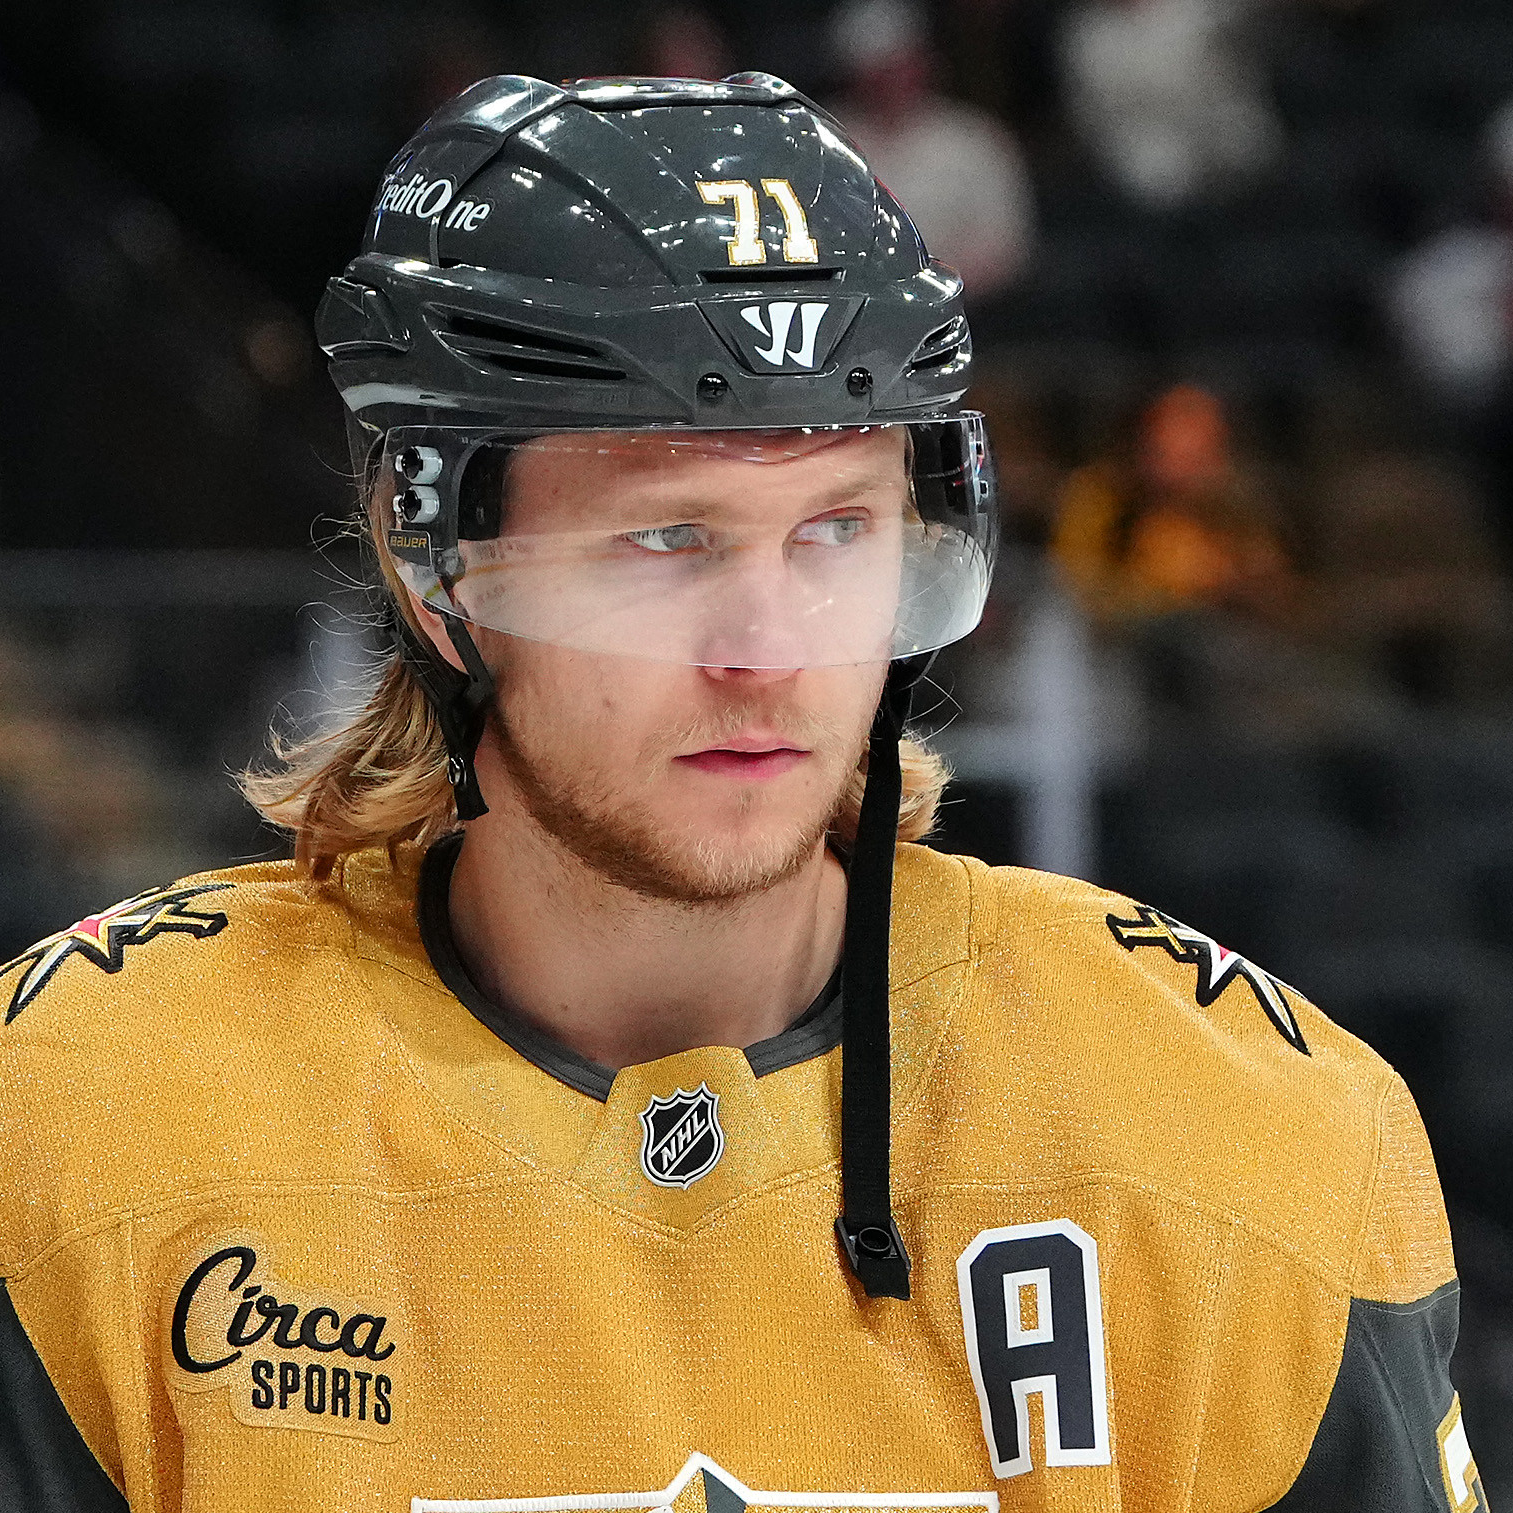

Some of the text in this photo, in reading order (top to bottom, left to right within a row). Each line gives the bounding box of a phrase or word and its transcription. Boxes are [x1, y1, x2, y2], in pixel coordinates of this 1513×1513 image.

[695, 178, 819, 266] 71
[390, 535, 427, 549] BAUER
[660, 1110, 706, 1172] NHL
[171, 1246, 396, 1373] Circa
[957, 1218, 1112, 1480] A
[251, 1359, 392, 1426] SPORTS
